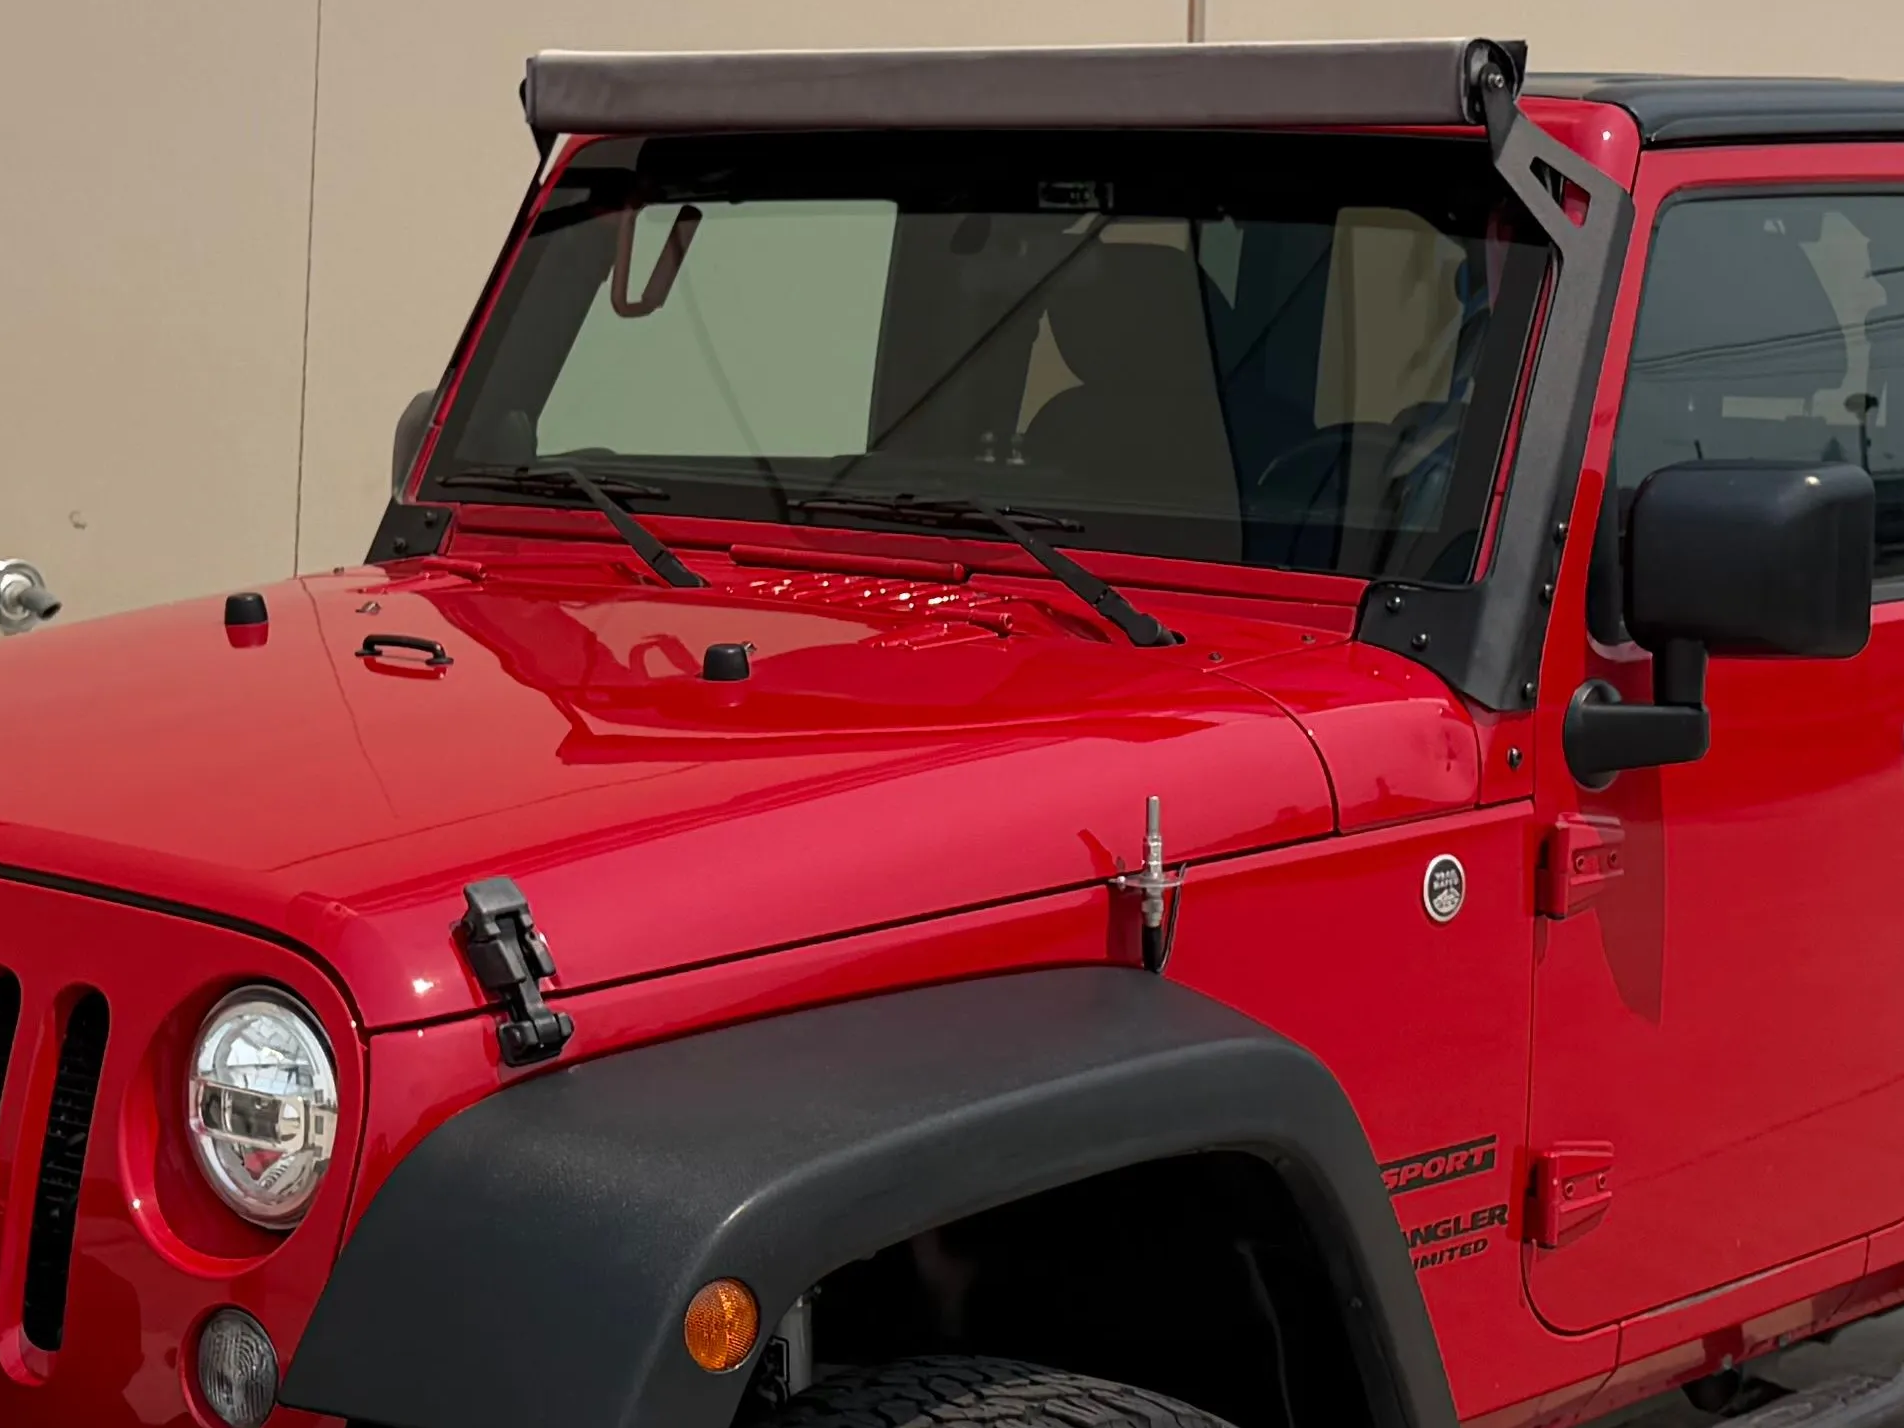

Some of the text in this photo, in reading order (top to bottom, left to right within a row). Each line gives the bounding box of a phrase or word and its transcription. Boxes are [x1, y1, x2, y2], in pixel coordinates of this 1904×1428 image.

[1380, 1142, 1496, 1190] SPORT
[1403, 1203, 1508, 1248] NGLER
[1413, 1238, 1488, 1270] IMITED
